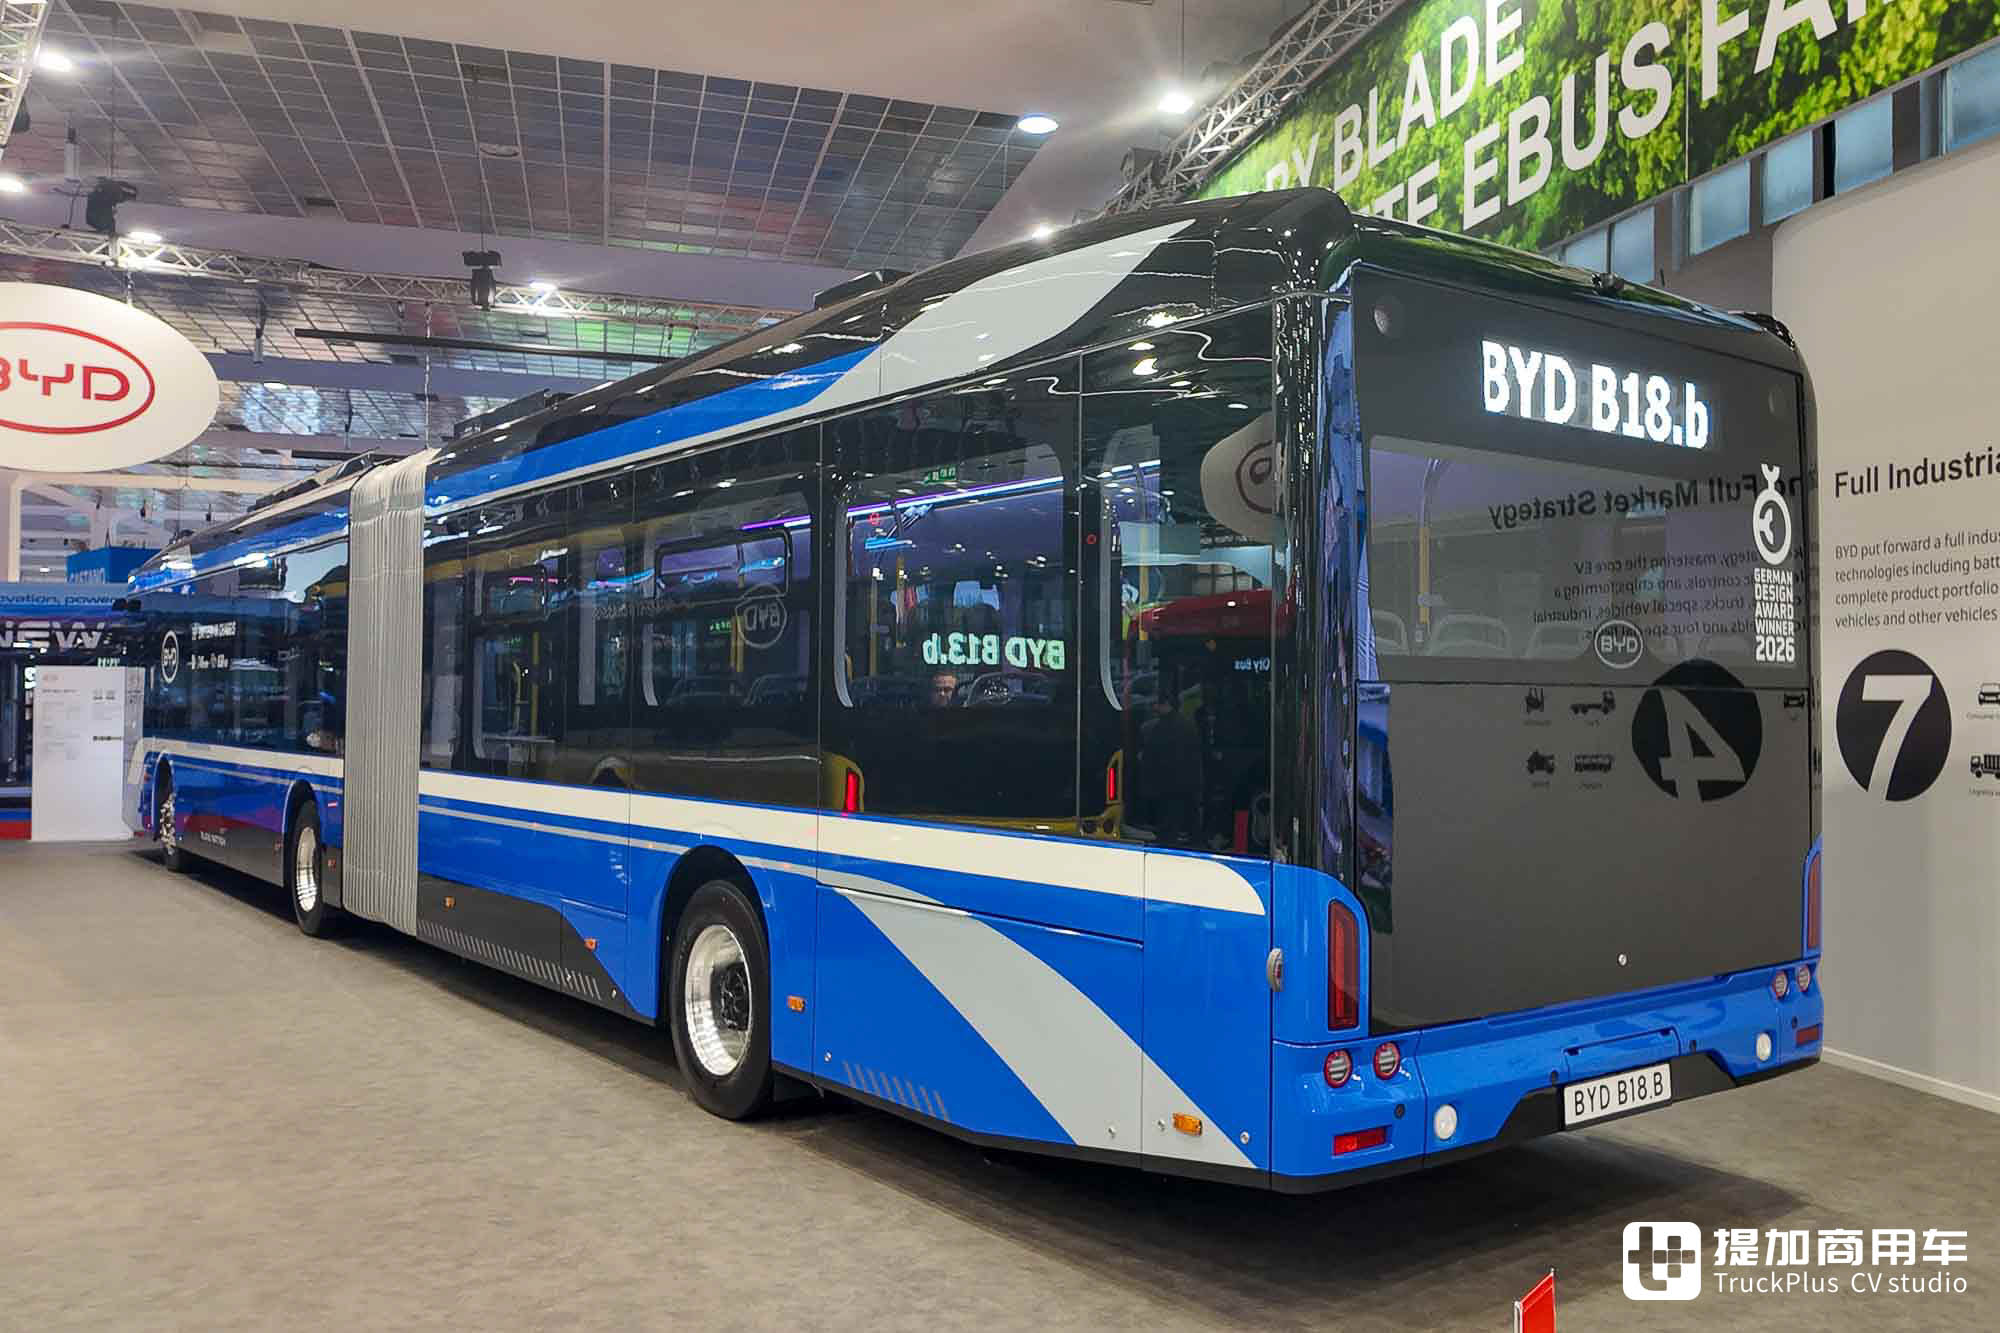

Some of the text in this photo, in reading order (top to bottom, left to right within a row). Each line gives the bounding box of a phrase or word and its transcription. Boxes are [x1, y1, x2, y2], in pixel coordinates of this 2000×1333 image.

[1334, 0, 1525, 191] BLADE
[1464, 22, 1673, 232] EBUS
[1701, 0, 1890, 101] FA
[1482, 340, 1709, 449] BYD B18.b
[1835, 465, 1879, 499] Full
[1835, 543, 1859, 560] BYD
[1861, 543, 1881, 560] put
[1883, 536, 1931, 555] forward
[1933, 538, 1942, 550] a
[1944, 530, 1965, 549] full
[1753, 567, 1793, 586] GERMAN
[1835, 565, 1910, 583] technologies
[1912, 558, 1971, 577] including
[1753, 584, 1794, 603] DESIGN
[1835, 580, 1999, 608] complete product portfolio
[1754, 601, 1795, 620] AWARD
[1835, 607, 1999, 629] vehicles and other vehicles
[1754, 618, 1796, 637] WINNER
[1600, 635, 1639, 653] BYD
[1754, 635, 1796, 663] 2026
[1862, 674, 1934, 801] 7
[1574, 1071, 1664, 1116] BYD B18.B
